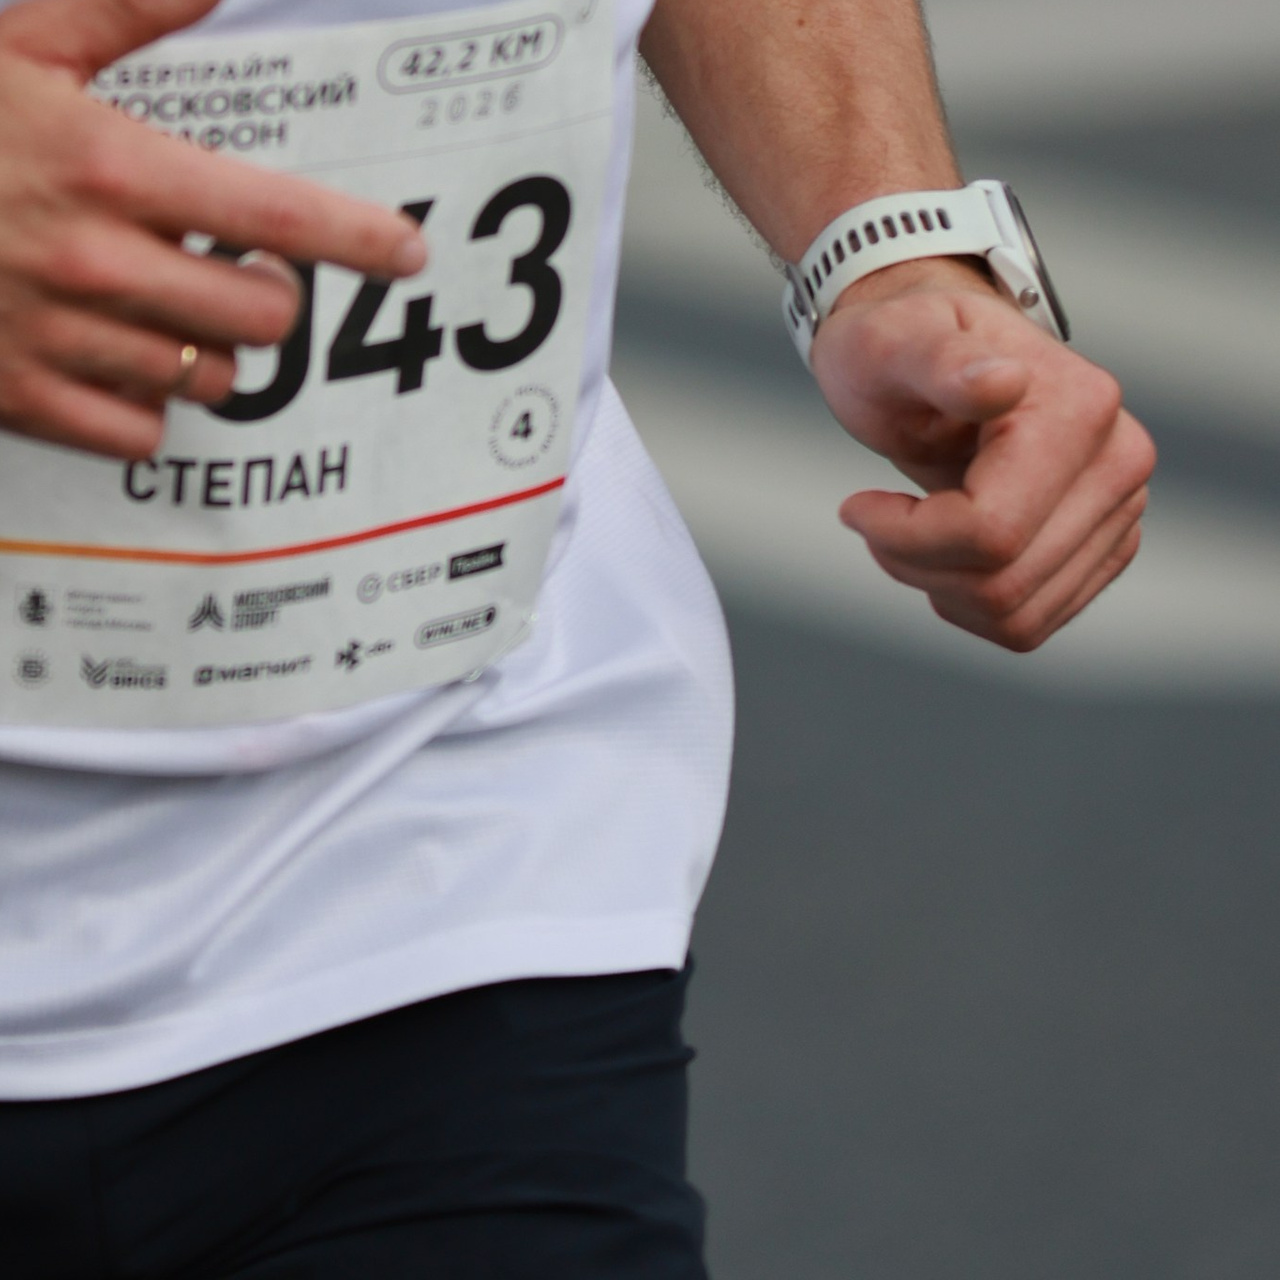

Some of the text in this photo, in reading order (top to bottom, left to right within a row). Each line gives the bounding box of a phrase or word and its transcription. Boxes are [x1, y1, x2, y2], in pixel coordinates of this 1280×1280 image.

[94, 53, 293, 90] СБЕРПРАЙМ
[508, 408, 536, 441] 4
[122, 441, 351, 507] СТЕПАН
